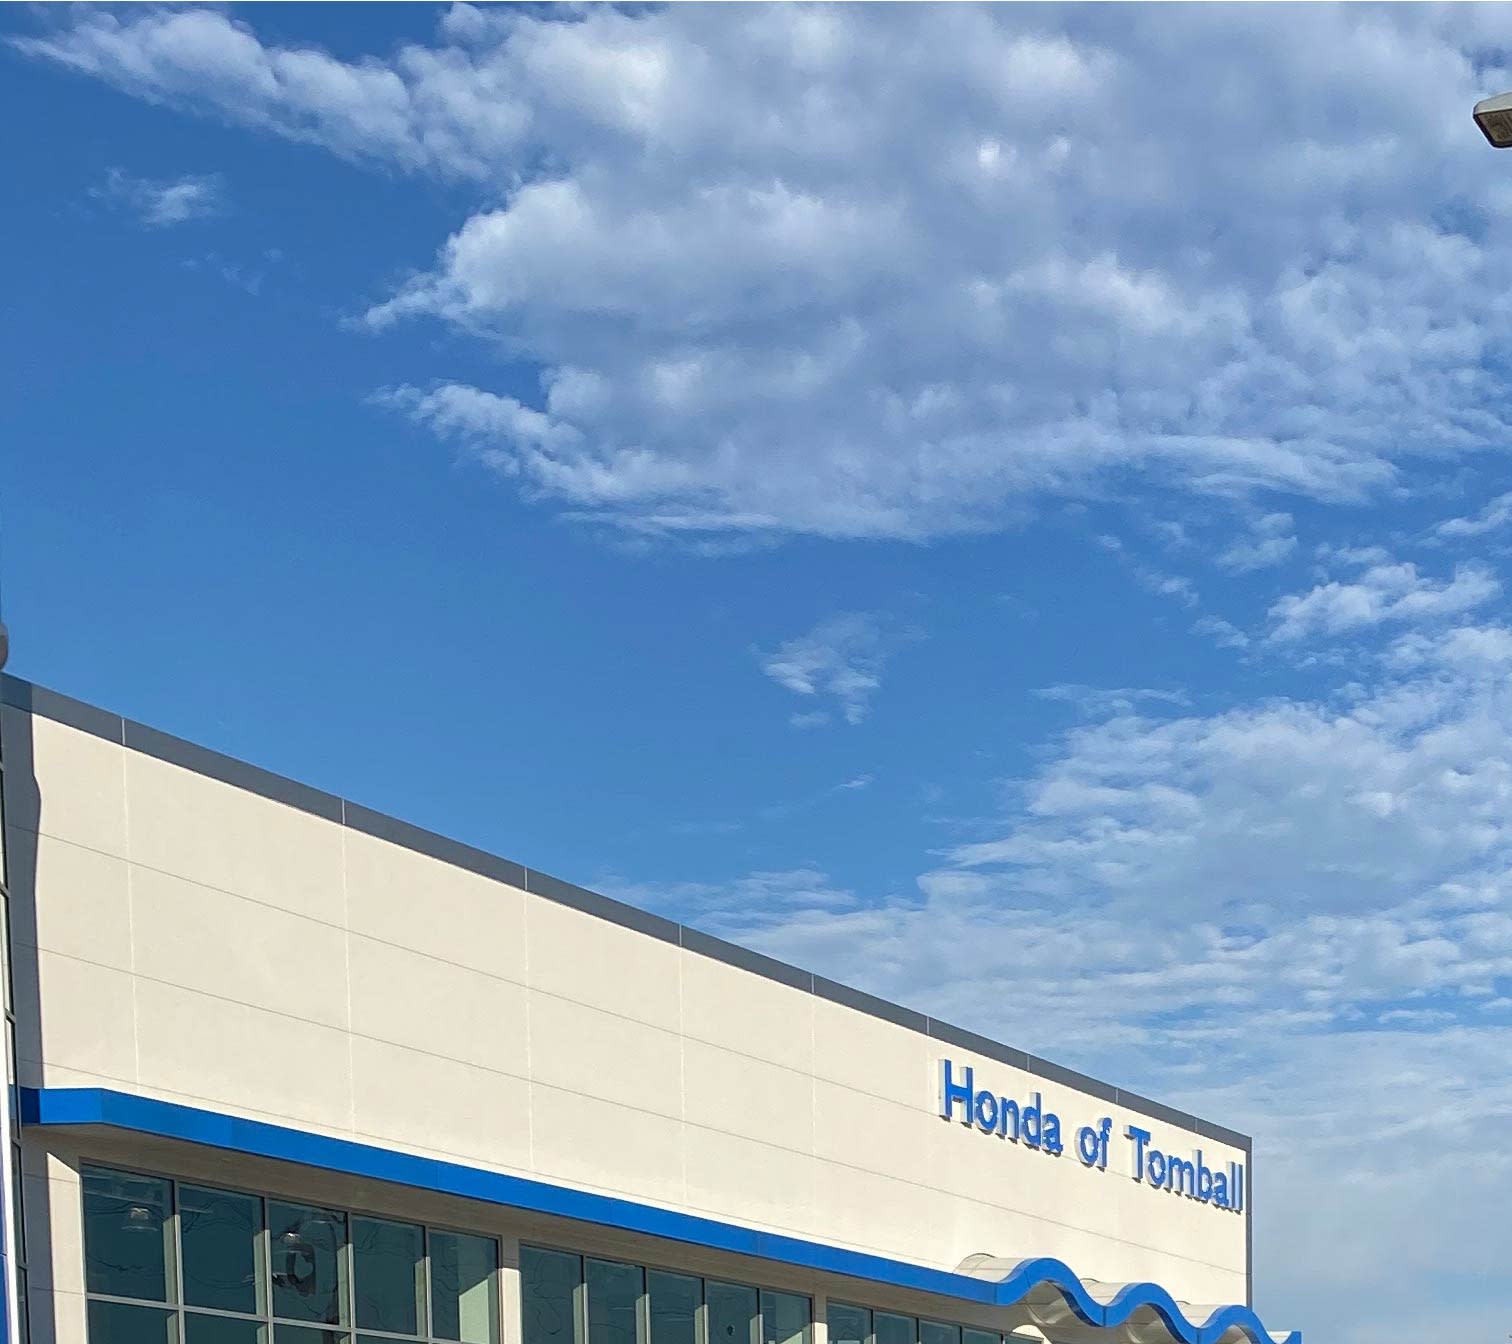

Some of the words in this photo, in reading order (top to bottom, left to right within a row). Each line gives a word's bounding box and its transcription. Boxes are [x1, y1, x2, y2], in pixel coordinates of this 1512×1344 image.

[938, 1058, 1064, 1156] Honda
[1074, 1117, 1112, 1170] of
[1123, 1124, 1244, 1214] Tomball
